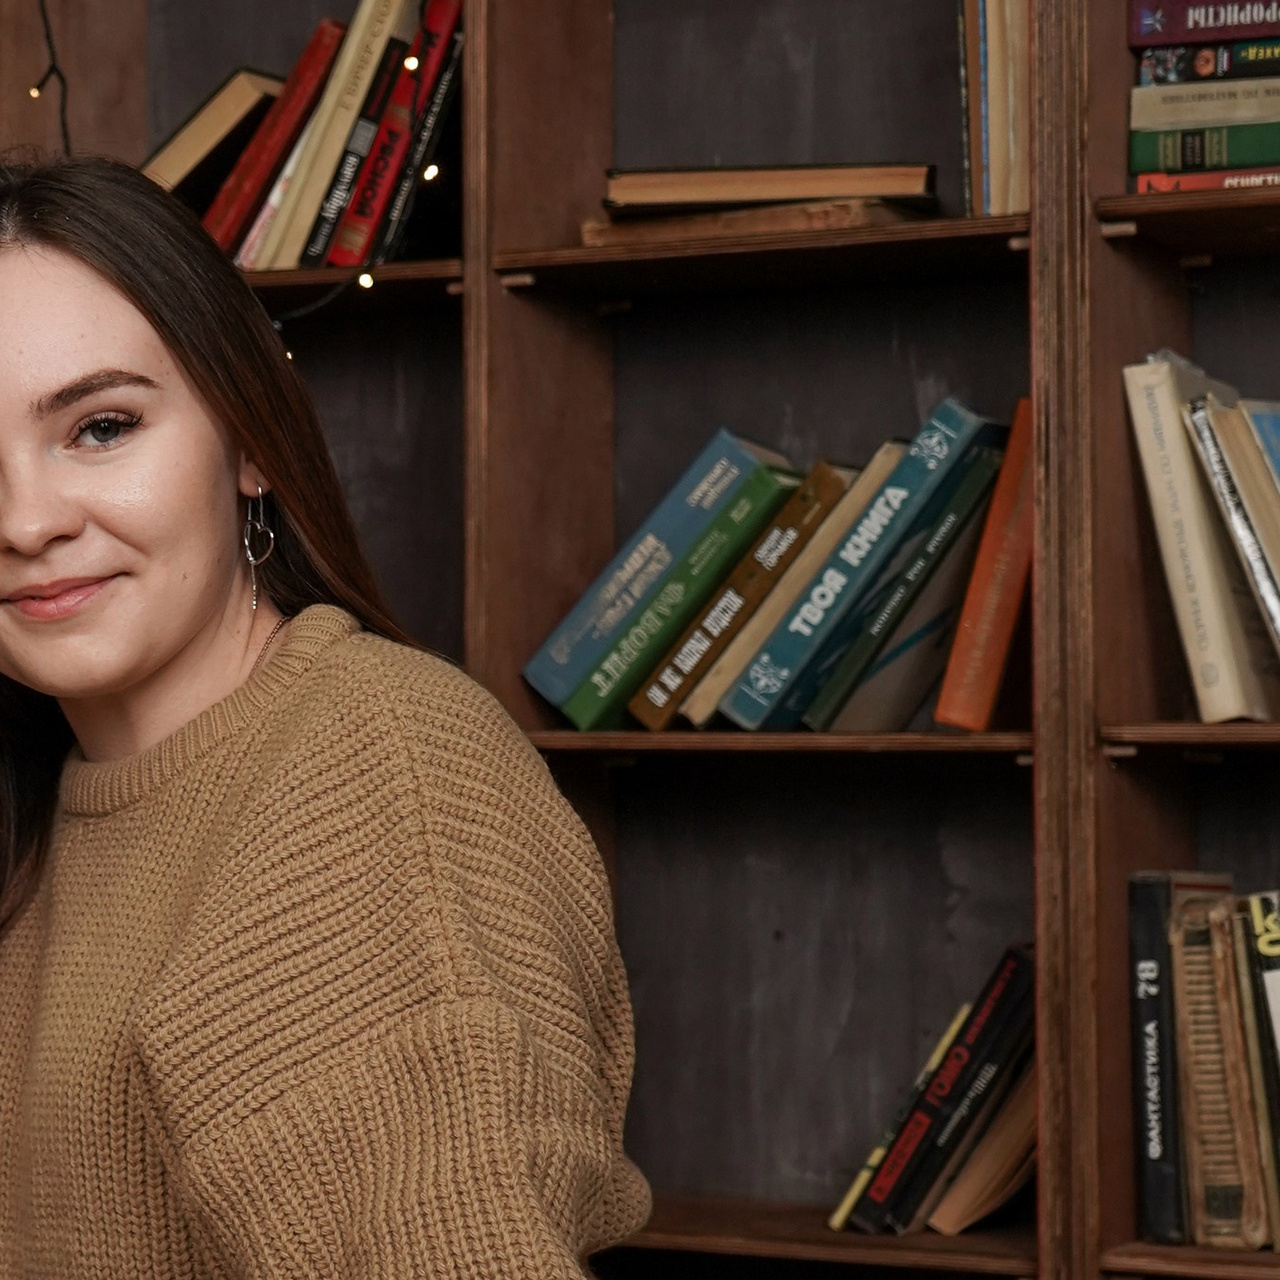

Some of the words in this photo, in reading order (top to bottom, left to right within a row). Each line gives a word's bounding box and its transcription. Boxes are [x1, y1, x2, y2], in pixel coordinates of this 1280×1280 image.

[1187, 0, 1280, 30] РОРИСТЫ
[787, 565, 850, 641] ТВОЯ
[836, 478, 910, 570] КНИГА
[584, 573, 691, 701] ФАВОРИТ
[1135, 958, 1160, 999] 78
[1143, 1020, 1163, 1159] ФАНТАСТИКА
